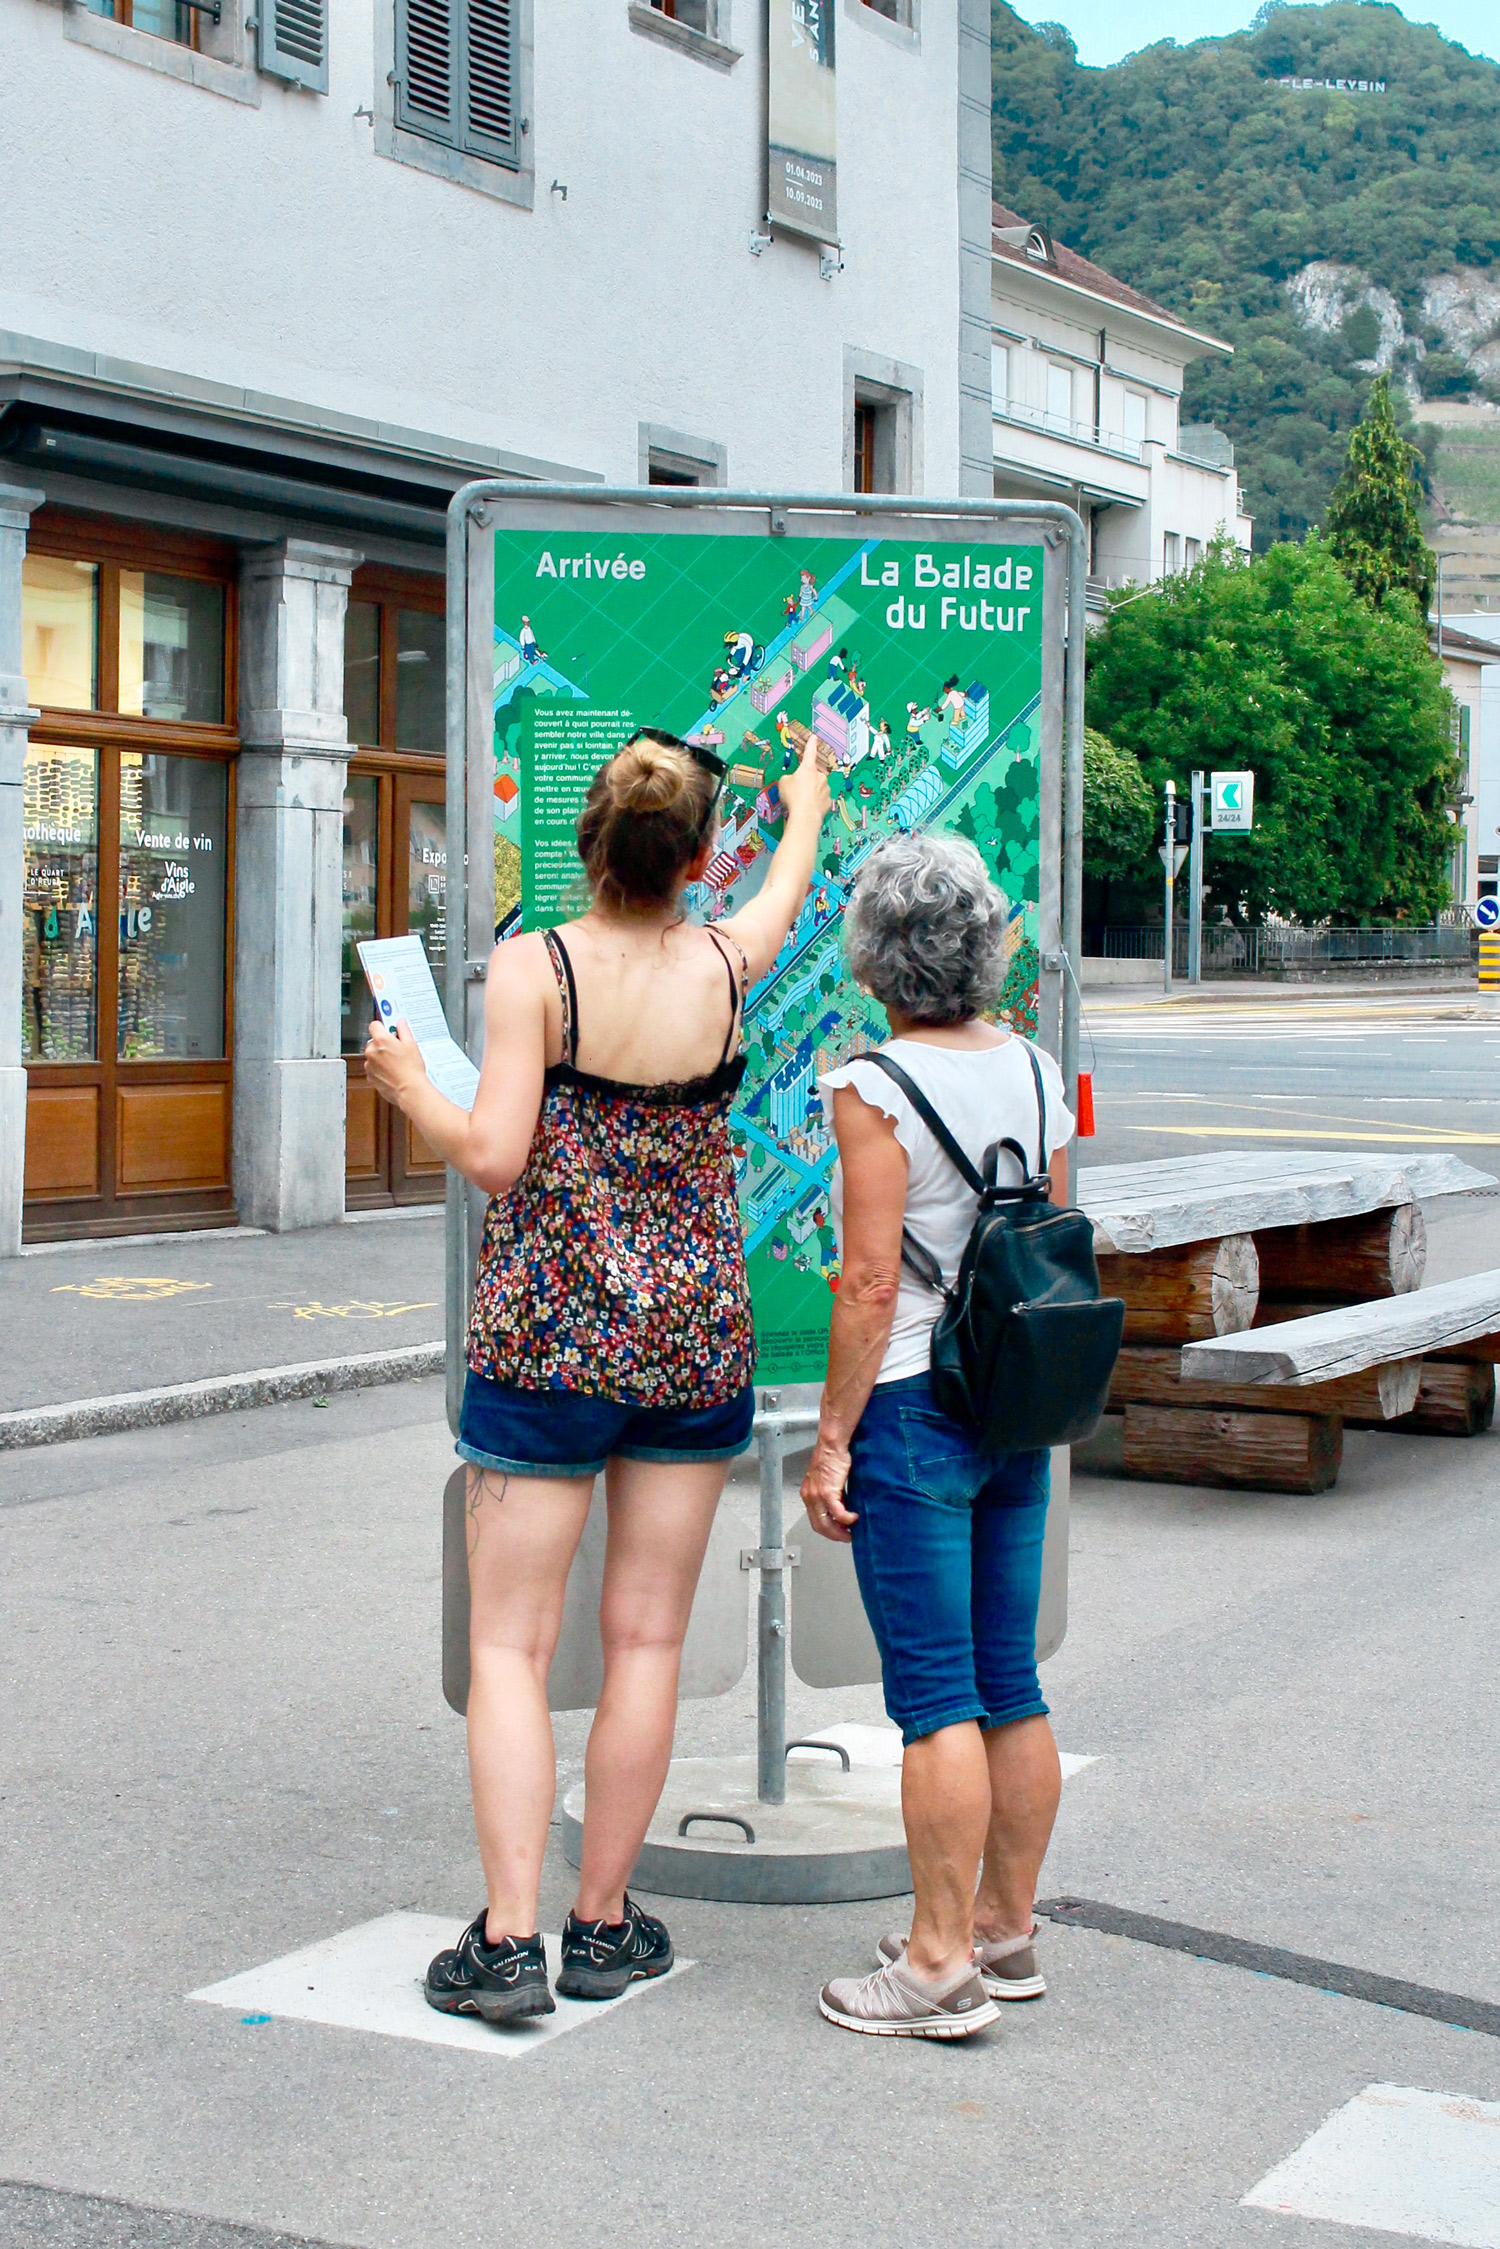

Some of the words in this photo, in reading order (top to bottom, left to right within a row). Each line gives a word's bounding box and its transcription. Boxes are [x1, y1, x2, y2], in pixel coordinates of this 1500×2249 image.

[785, 161, 823, 186] 01.04.2023
[785, 186, 823, 211] 10.09.2023
[535, 551, 646, 580] Arrivée
[861, 552, 899, 587] La
[915, 553, 1033, 591] Balade
[886, 595, 926, 629] du
[941, 596, 1031, 632] Futur
[534, 708, 554, 717] Vous
[576, 709, 619, 717] maintenant
[534, 720, 563, 728] couvert
[572, 720, 589, 728] quoi
[591, 720, 621, 729] pourrait
[534, 731, 565, 739] sembler
[589, 731, 605, 739] ville
[606, 731, 626, 739] dans
[560, 743, 574, 751] pas
[541, 753, 568, 761] arriver,
[534, 763, 577, 772] aujourd'hui
[562, 807, 580, 816] plan
[1217, 814, 1242, 822] 24/24
[135, 829, 172, 849] Vente
[174, 832, 190, 850] de
[192, 832, 213, 851] vin
[30, 868, 39, 876] LE
[164, 860, 190, 878] Vins
[160, 876, 196, 899] d'Aigle
[582, 1935, 616, 1951] SALOMON
[492, 1950, 529, 1969] SALOMON
